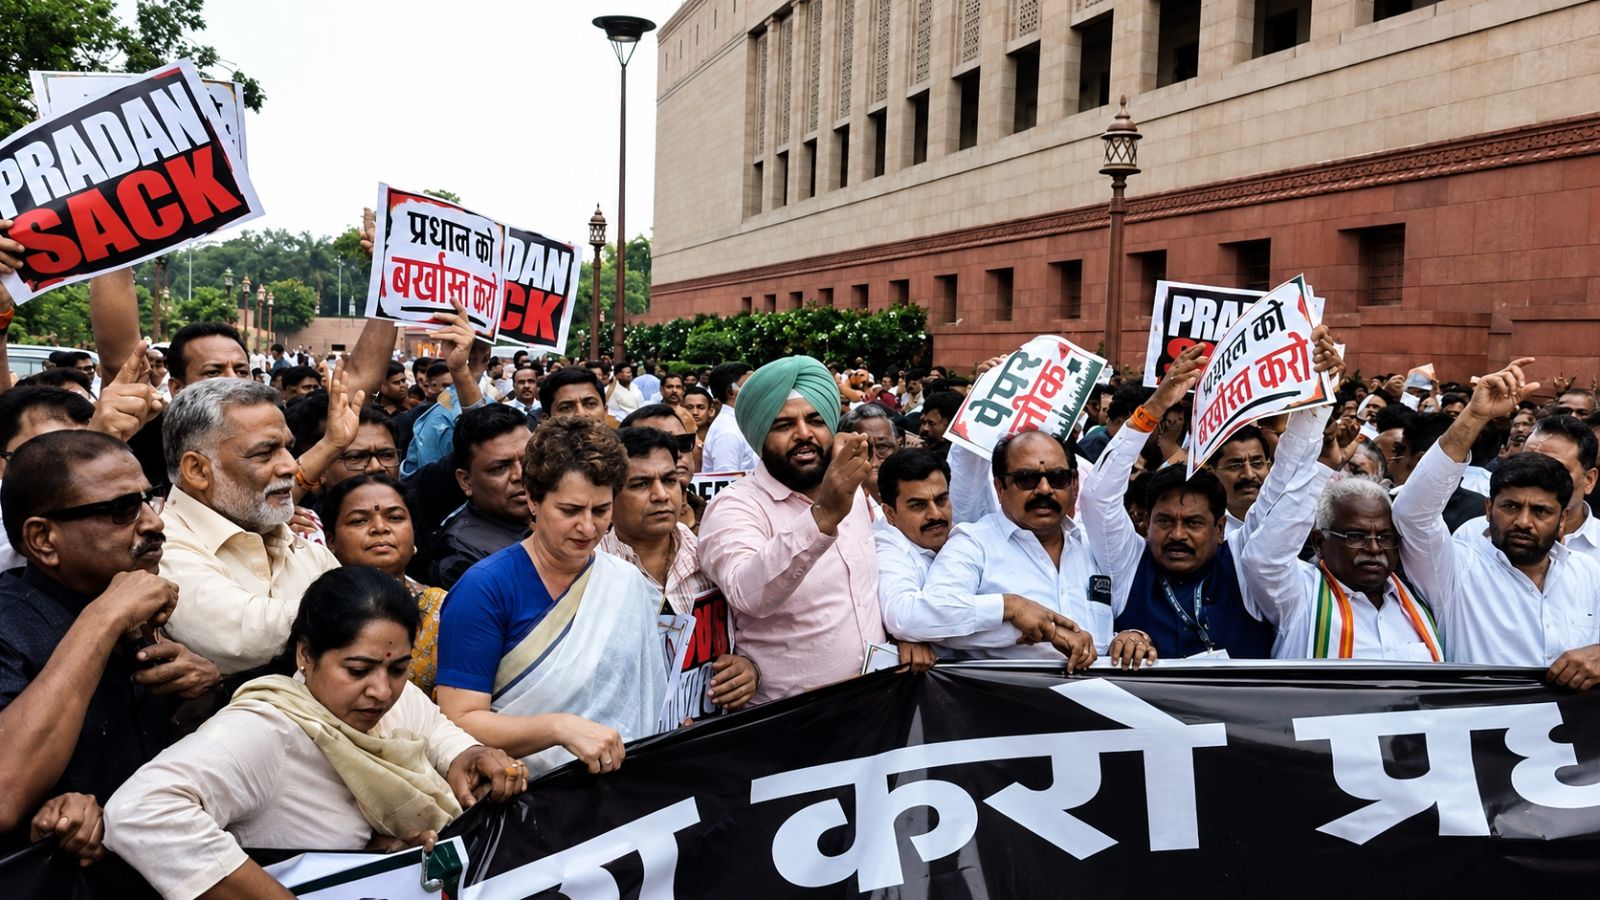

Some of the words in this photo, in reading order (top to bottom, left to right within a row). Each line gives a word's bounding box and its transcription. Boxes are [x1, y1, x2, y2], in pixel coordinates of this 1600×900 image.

[0, 81, 210, 220] PRADAN
[8, 145, 242, 274] SACK
[474, 227, 495, 267] को
[504, 236, 571, 295] DAN
[500, 280, 563, 341] CK
[1167, 295, 1254, 341] PRA
[1251, 299, 1286, 342] को
[968, 350, 1043, 427] पेपर
[1255, 331, 1311, 389] करो
[750, 678, 1228, 893] करो
[1292, 702, 1600, 846] प्रध
